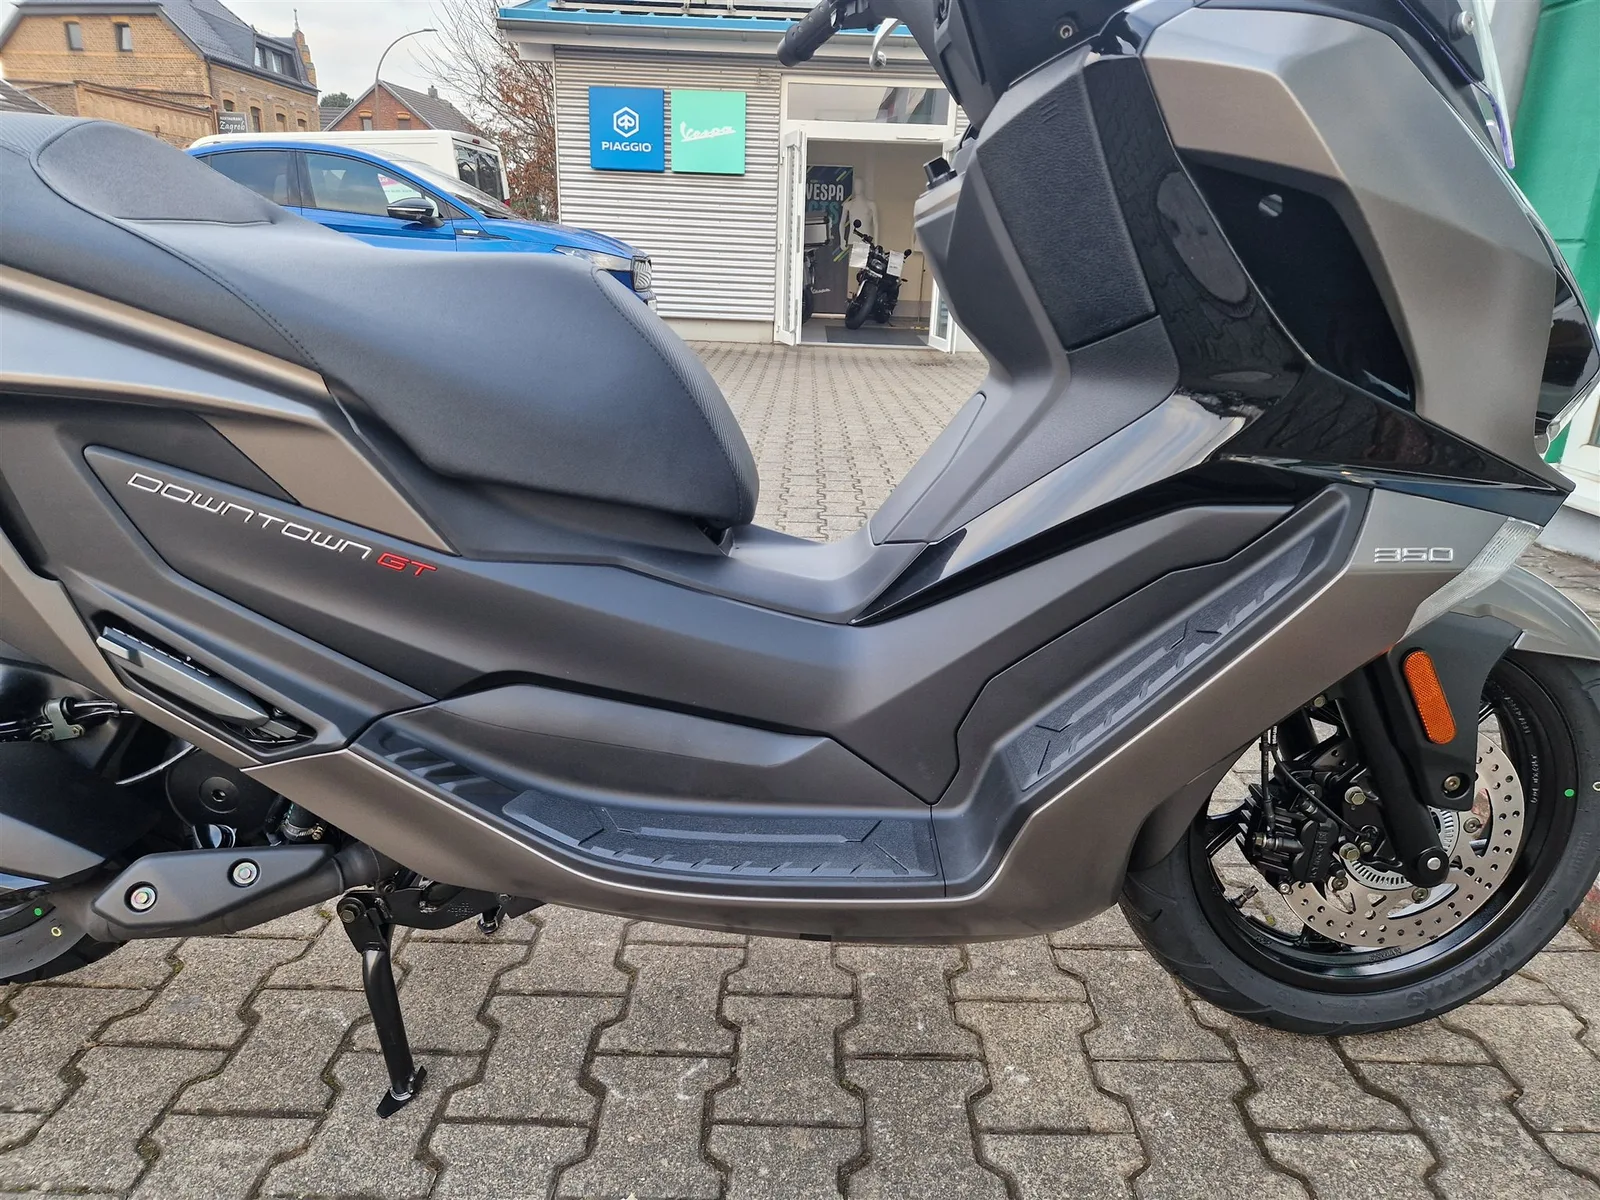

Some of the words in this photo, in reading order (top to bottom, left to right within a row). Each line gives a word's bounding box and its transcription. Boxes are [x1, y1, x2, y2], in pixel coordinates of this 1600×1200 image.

[219, 120, 246, 134] Zagreb
[680, 121, 736, 142] Vespa
[601, 141, 652, 152] PIAGGIO
[806, 183, 844, 201] VESPA
[126, 472, 373, 560] DOWNTOWN
[376, 552, 438, 578] GT
[1374, 547, 1454, 563] 350
